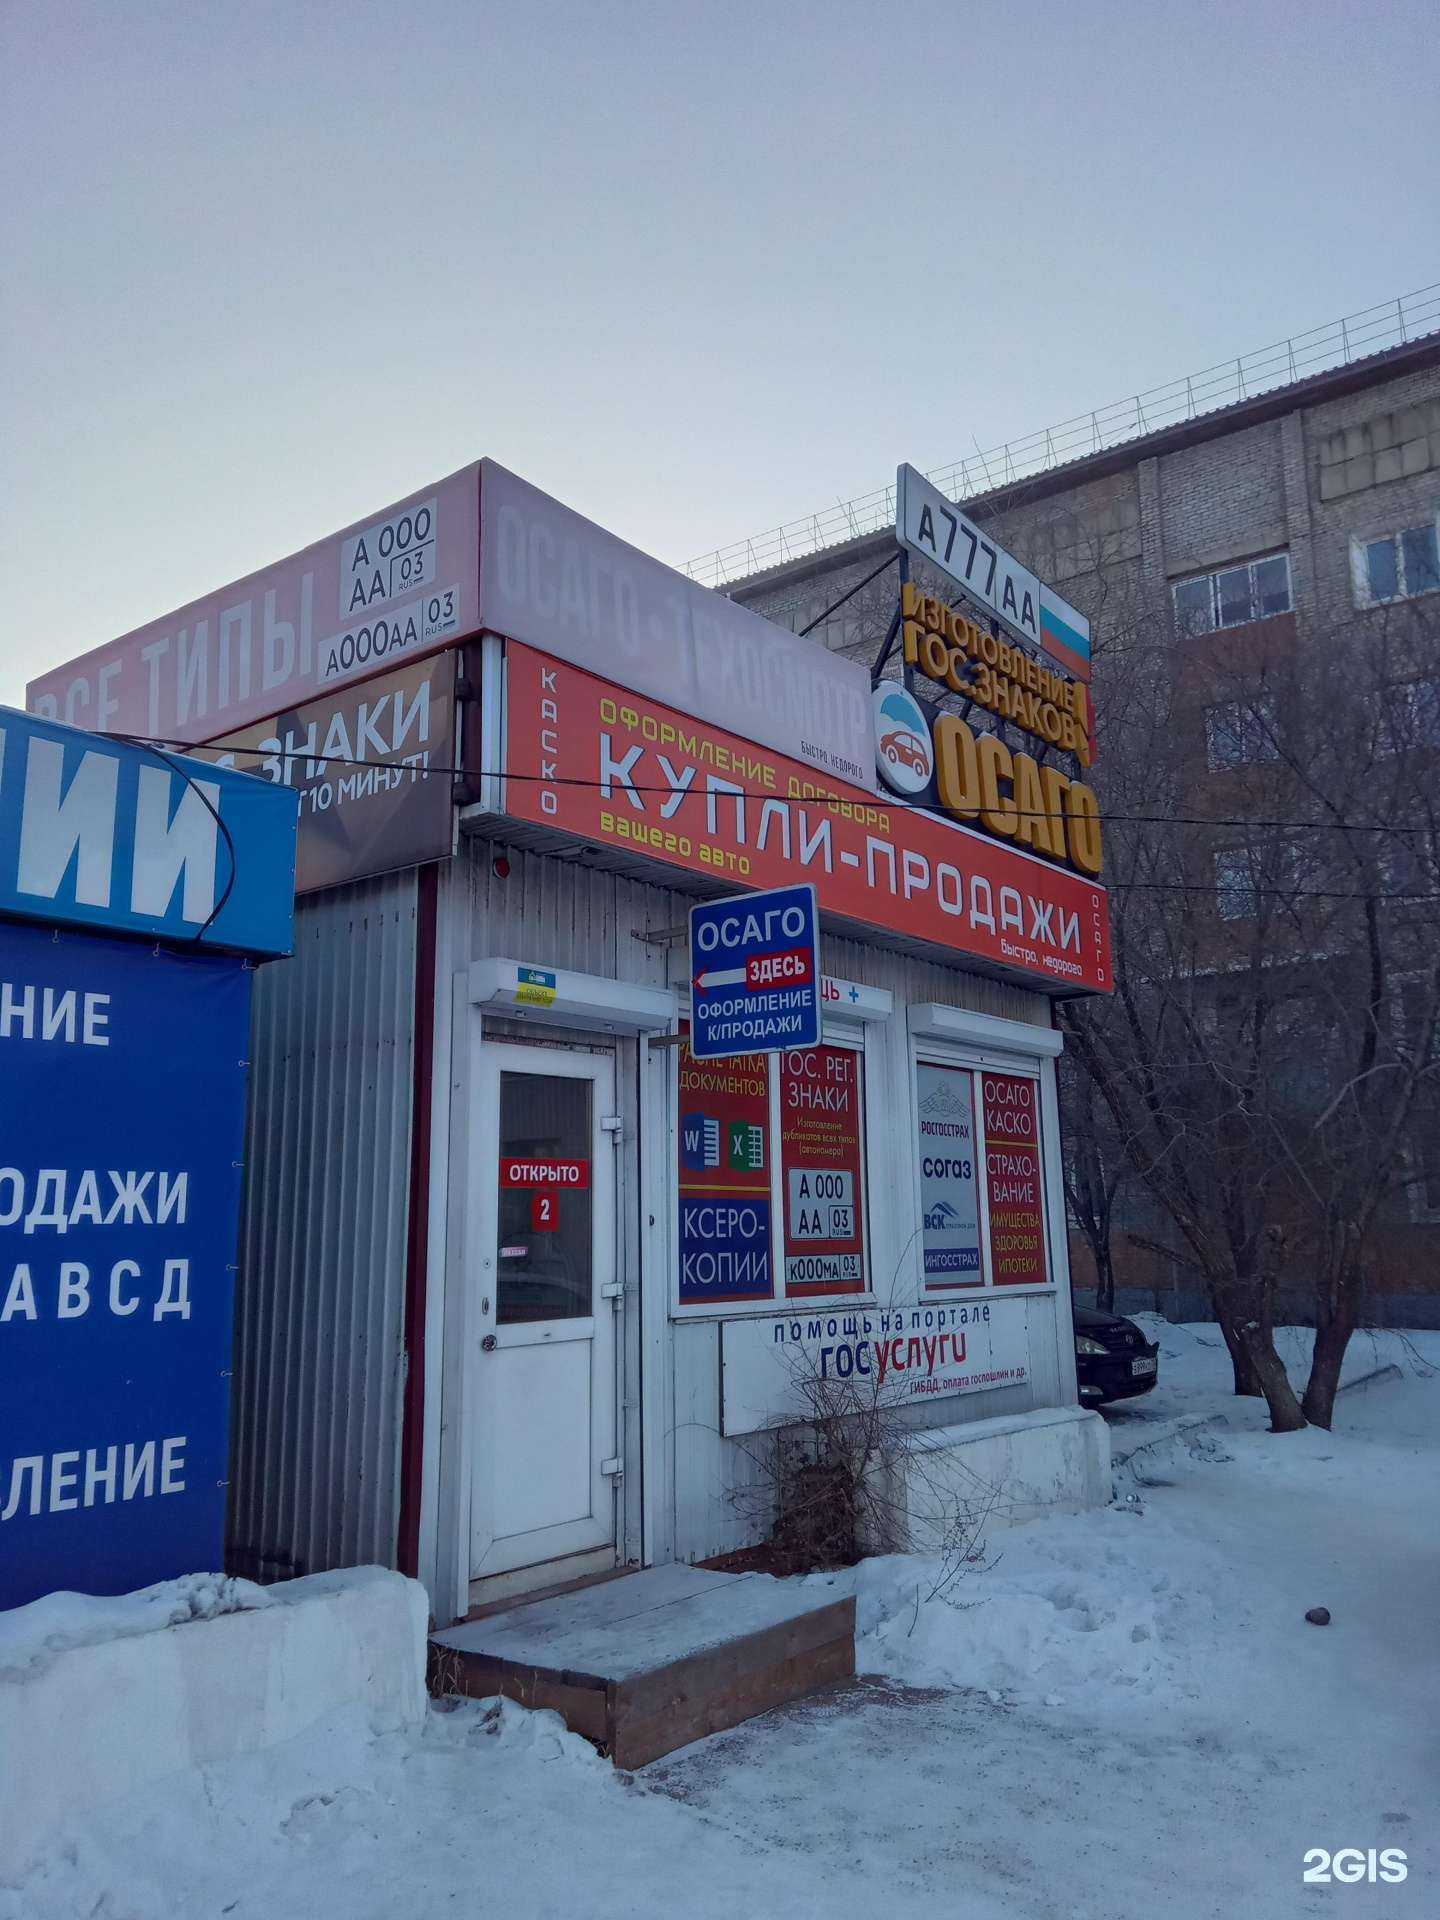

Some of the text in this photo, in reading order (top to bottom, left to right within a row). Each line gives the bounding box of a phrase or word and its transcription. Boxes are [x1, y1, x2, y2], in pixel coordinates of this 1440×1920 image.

[401, 550, 424, 580] 03
[399, 578, 414, 591] RUS
[428, 591, 454, 624] 03
[425, 623, 443, 636] RUS
[140, 571, 315, 739] ТИПЫ
[903, 581, 1074, 716] ИЗГОТОВЛЕНИЕ
[257, 680, 431, 785] ЗНАКИ
[541, 667, 558, 816] КАСКО
[600, 698, 891, 834] ОФОРМЛЕНИЕ ДОГОВОРА
[831, 753, 864, 780] НЕДОРОГО
[309, 782, 333, 813] 10
[337, 750, 430, 806] МИНУТ!
[933, 710, 1104, 874] ОСАГО
[0, 728, 221, 926] ИИ
[599, 732, 1082, 955] КУПЛИ-ПРОДАЖИ
[699, 844, 752, 876] авто
[697, 906, 806, 952] ОСАГО
[750, 955, 806, 983] ЗДЕСЬ
[697, 988, 813, 1020] ОФОРМЛЕНИЕ
[707, 1013, 803, 1042] К/ПРОДАЖИ
[826, 1055, 854, 1083] РЕГ.
[680, 1070, 767, 1097] ДОКУМЕНТОВ
[787, 1081, 849, 1113] ЗНАКИ
[984, 1080, 1030, 1107] ОСАГО
[921, 1120, 970, 1140] РОСГОССТРАХ
[985, 1108, 1032, 1135] КАСКО
[509, 1164, 579, 1183] ОТКРЫТО
[986, 1153, 1037, 1178] СТРАХО-
[992, 1180, 1034, 1205] ВАНИЕ
[540, 1198, 550, 1221] 2
[684, 1207, 766, 1239] КСЕРО-
[833, 1209, 848, 1228] 03
[923, 1214, 946, 1230] ВСК
[990, 1210, 1041, 1230] ИМУЩЕСТВА
[994, 1234, 1039, 1254] ЗДОРОВЬЯ
[682, 1251, 768, 1285] КОПИИ
[843, 1255, 856, 1271] 03
[924, 1252, 978, 1269] ИНГОССТРАХ
[998, 1256, 1038, 1274] ИПОТЕКИ
[773, 1304, 991, 1343] помощь на портале
[943, 1376, 970, 1390] оплата
